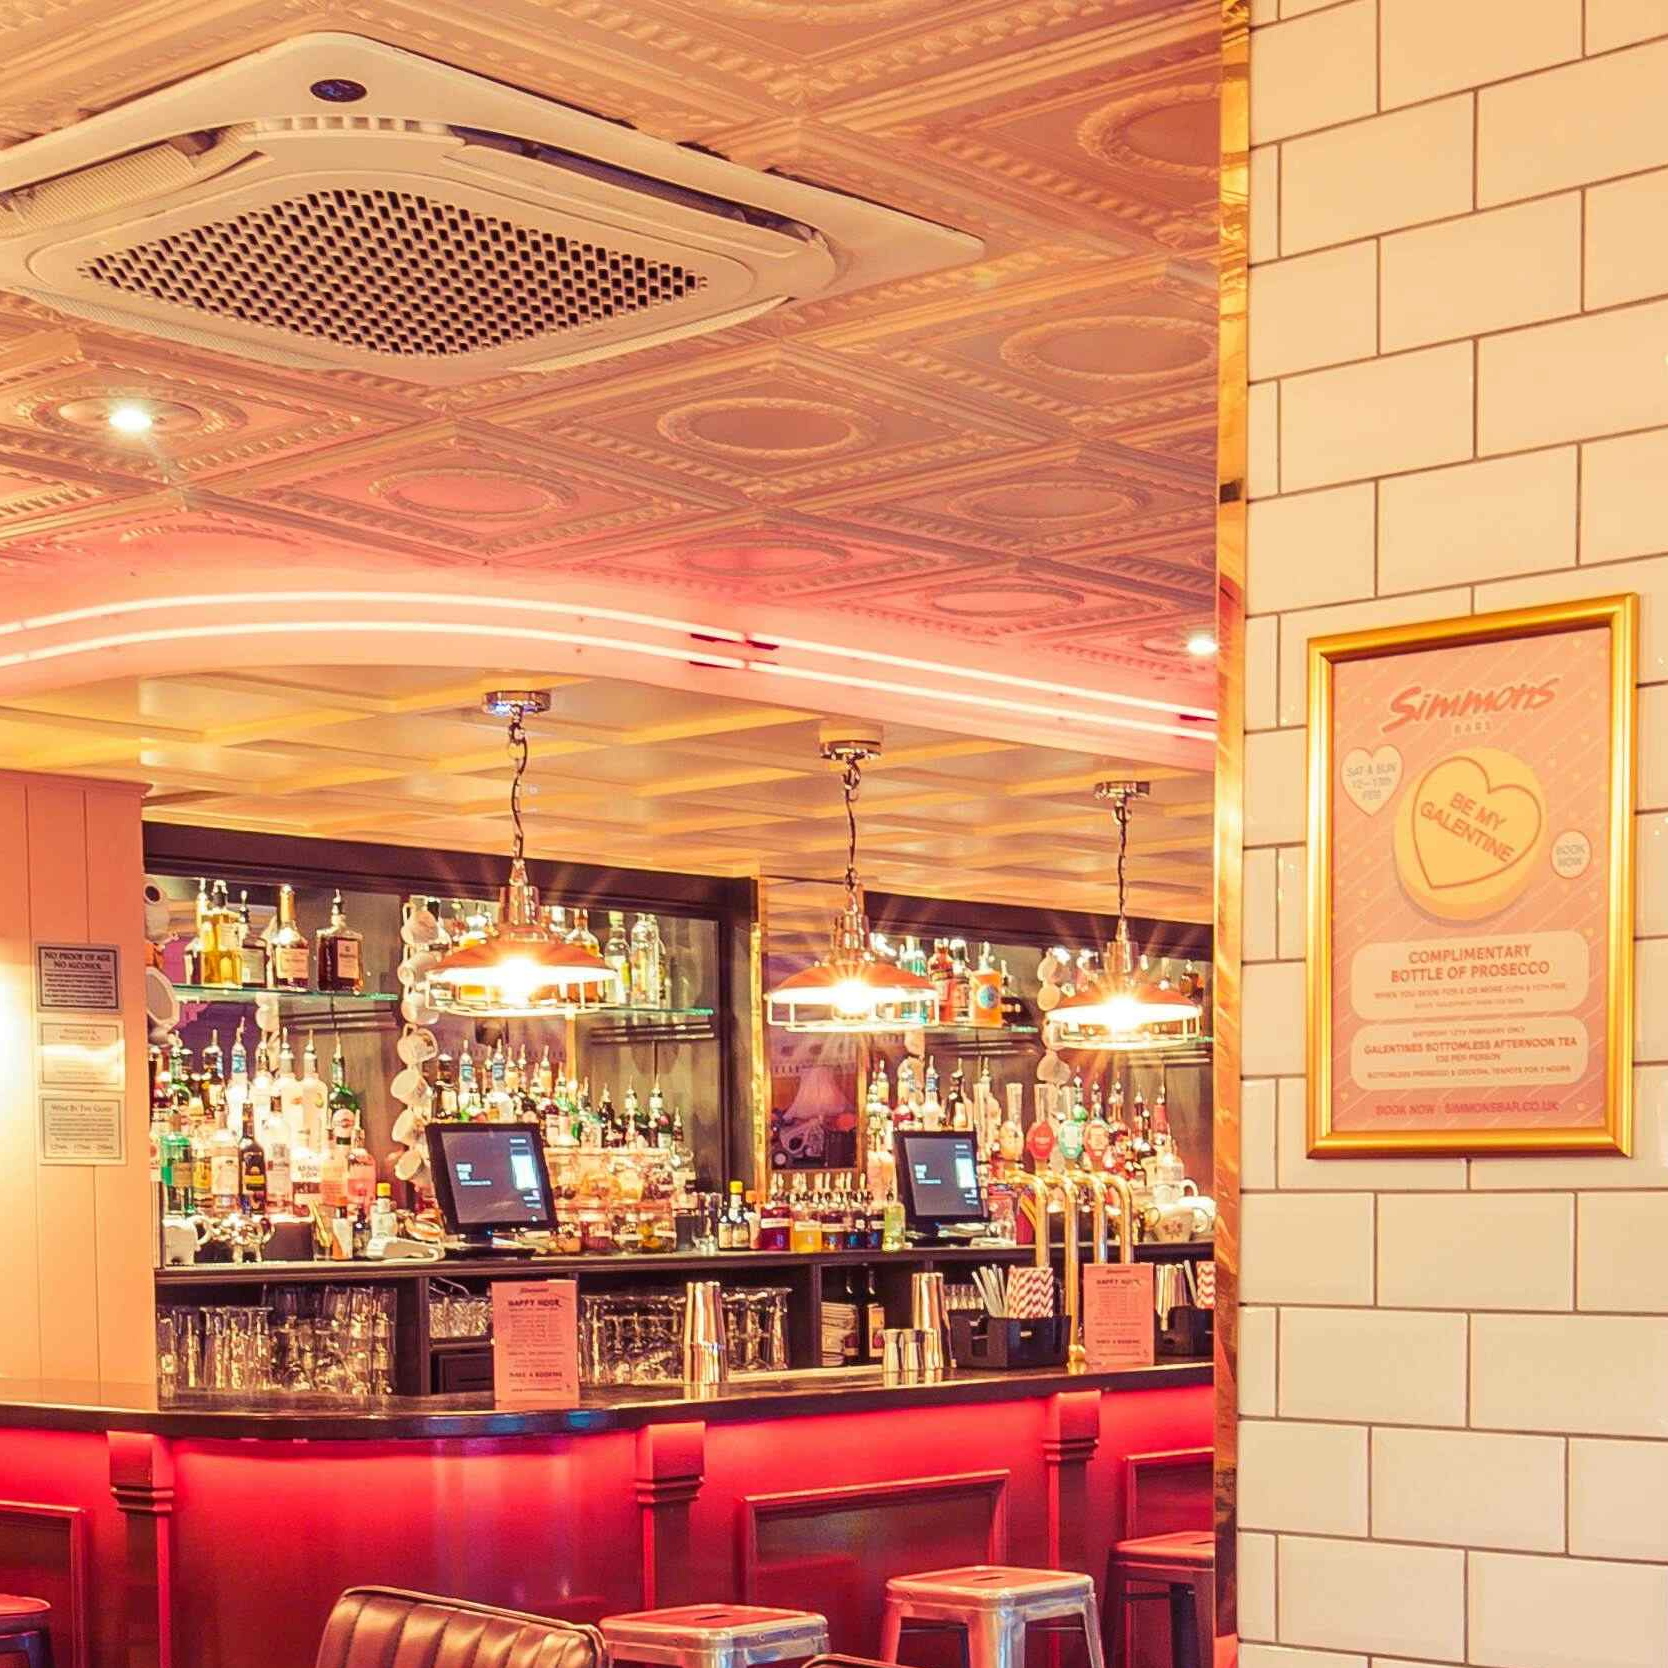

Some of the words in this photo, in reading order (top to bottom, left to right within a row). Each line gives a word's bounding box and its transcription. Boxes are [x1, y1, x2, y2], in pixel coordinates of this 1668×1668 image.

[1381, 677, 1560, 733] Simmons
[1449, 792, 1474, 817] BE
[1475, 804, 1507, 832] MY
[1420, 800, 1515, 863] GALENTINE
[1408, 944, 1532, 964] COMPLIMENTARY
[1390, 968, 1443, 983] BOTTLE
[1447, 966, 1467, 980] OF
[1471, 961, 1550, 978] PROSECCO
[1364, 1043, 1423, 1055] GALENTINES
[1425, 1040, 1491, 1052] BOTTOMLESS
[1493, 1038, 1555, 1049] AFTERNOON
[1558, 1037, 1577, 1047] TEA
[1375, 1104, 1407, 1116] BOOK
[1409, 1103, 1435, 1115] NOW
